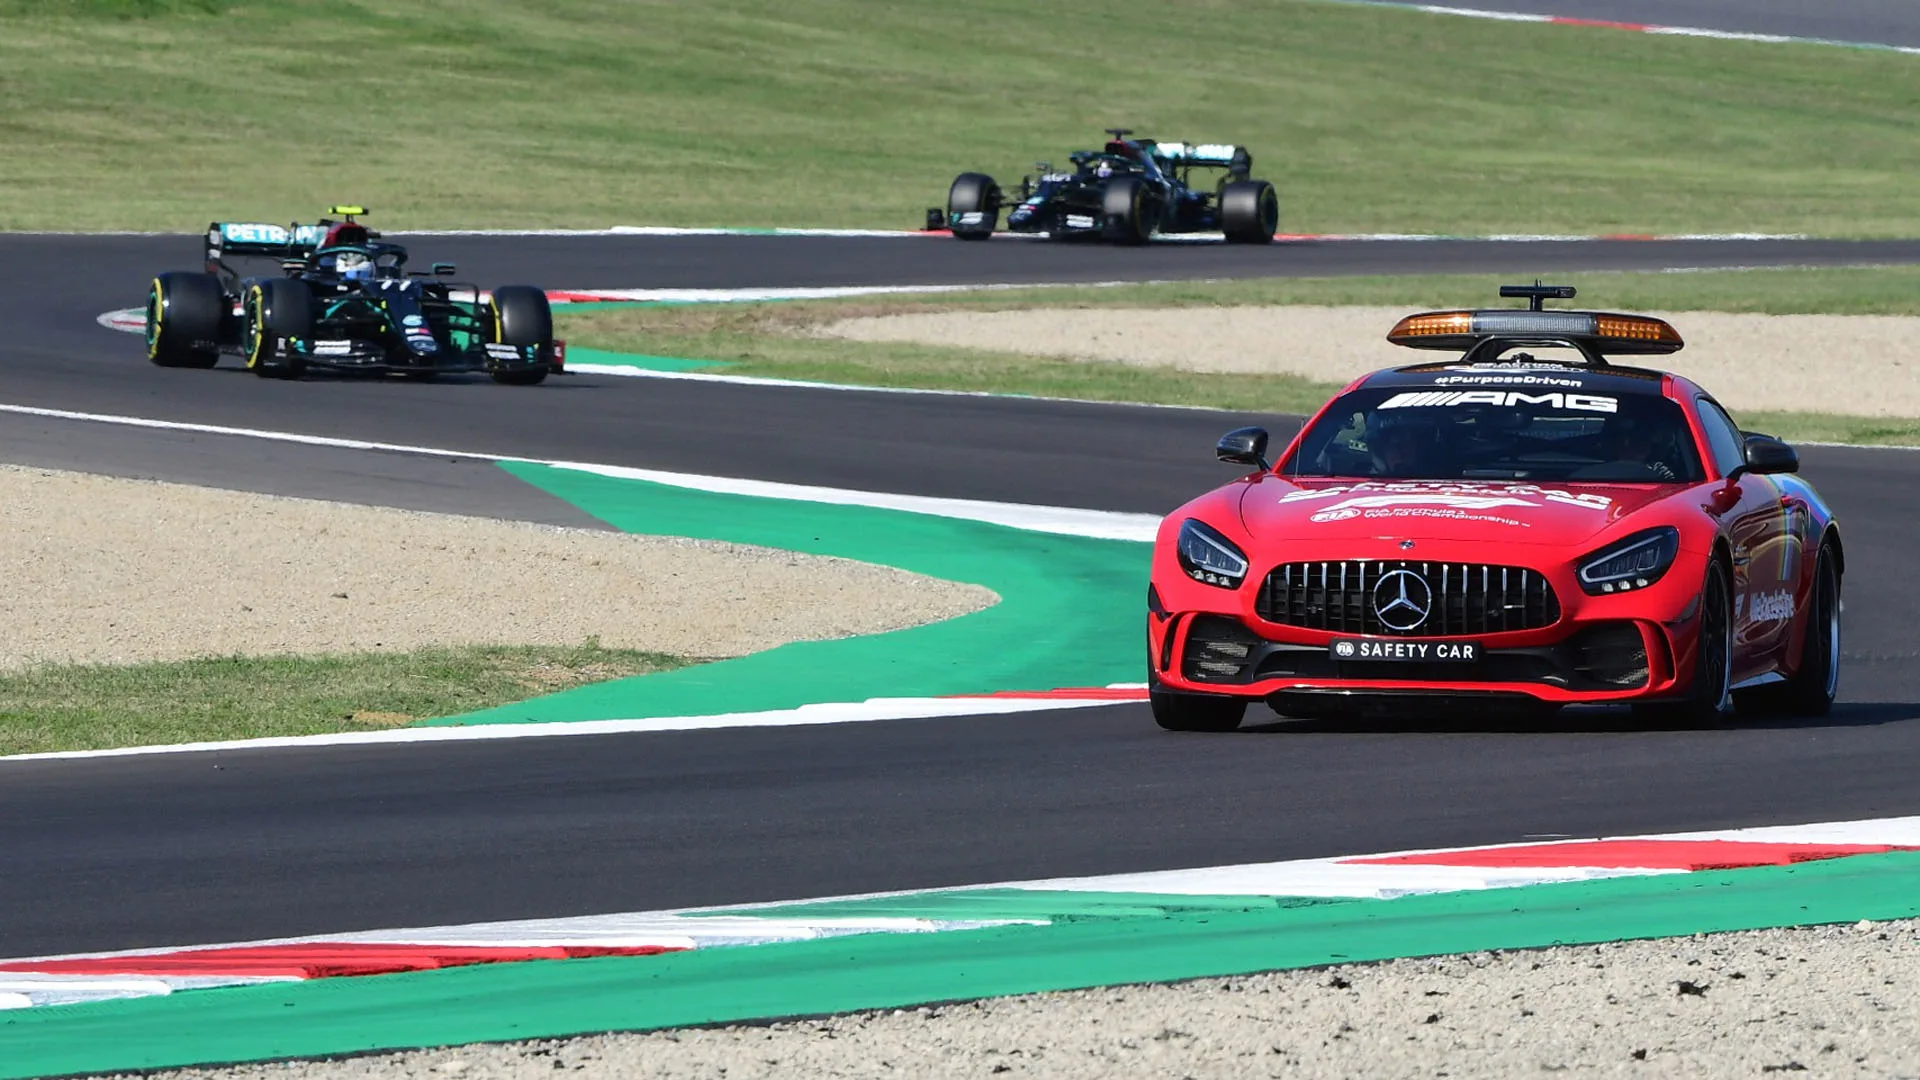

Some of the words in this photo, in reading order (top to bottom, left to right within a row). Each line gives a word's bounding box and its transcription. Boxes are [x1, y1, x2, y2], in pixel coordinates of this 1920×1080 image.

[1434, 376, 1583, 388] #PurposeDriven
[1445, 391, 1618, 413] AMG
[1360, 642, 1428, 658] SAFETY
[1436, 644, 1473, 659] CAR
